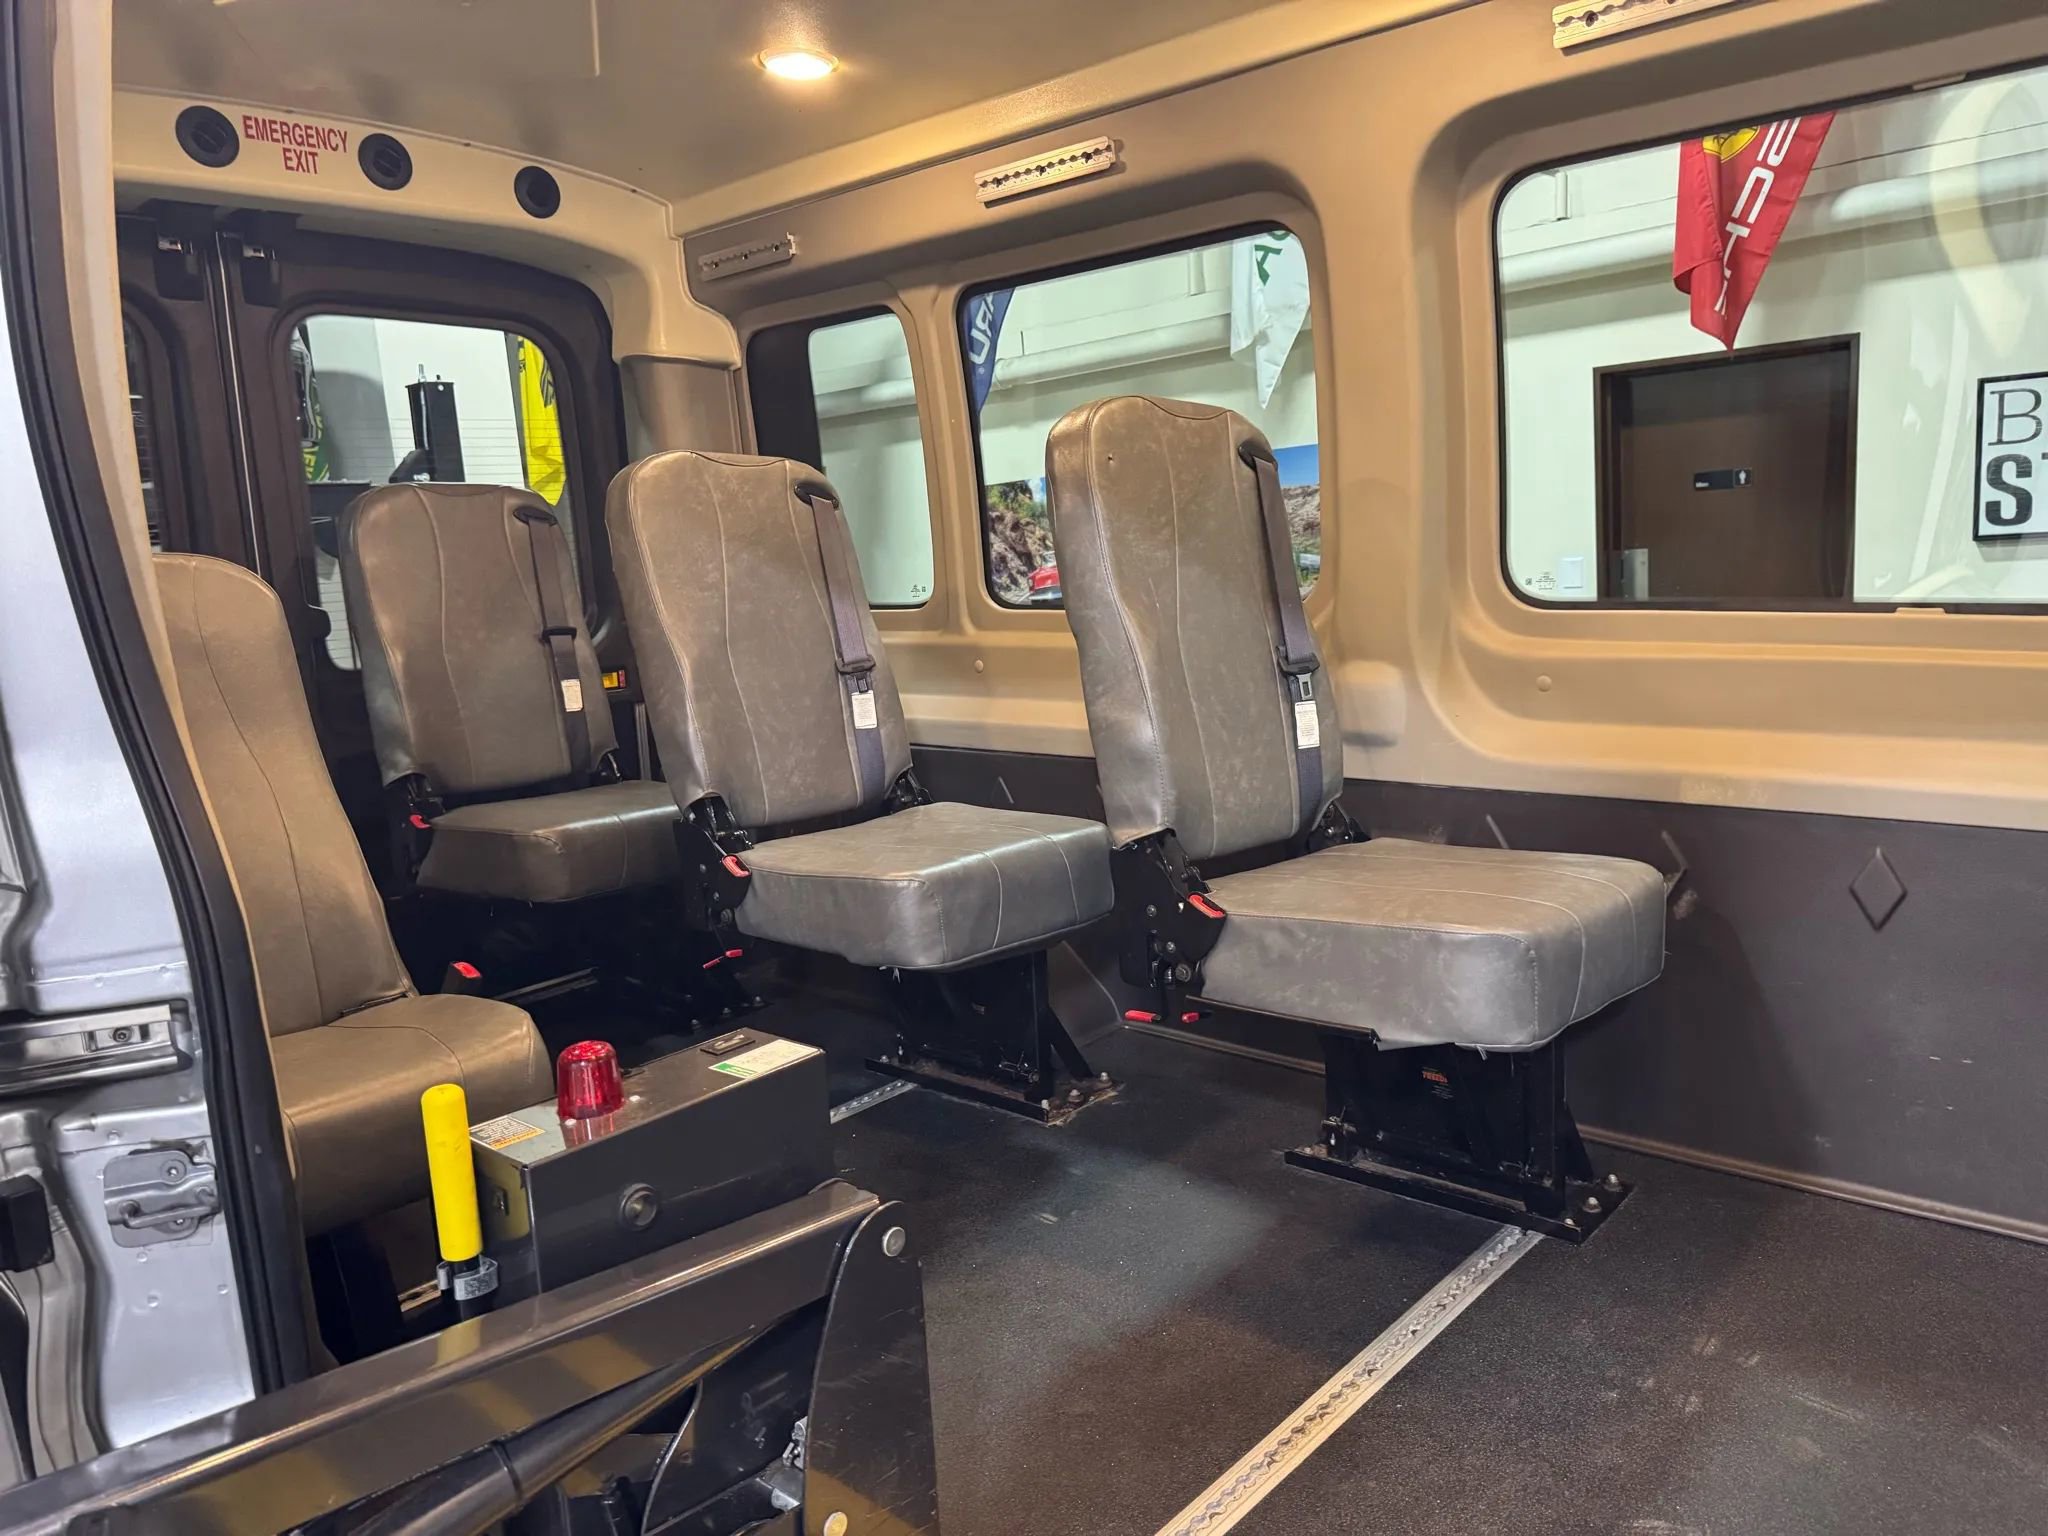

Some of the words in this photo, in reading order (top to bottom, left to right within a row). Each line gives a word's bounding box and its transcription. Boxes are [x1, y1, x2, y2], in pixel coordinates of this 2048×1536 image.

[242, 114, 348, 153] EMERGENCY
[282, 147, 319, 175] EXIT
[1985, 453, 2048, 527] S
